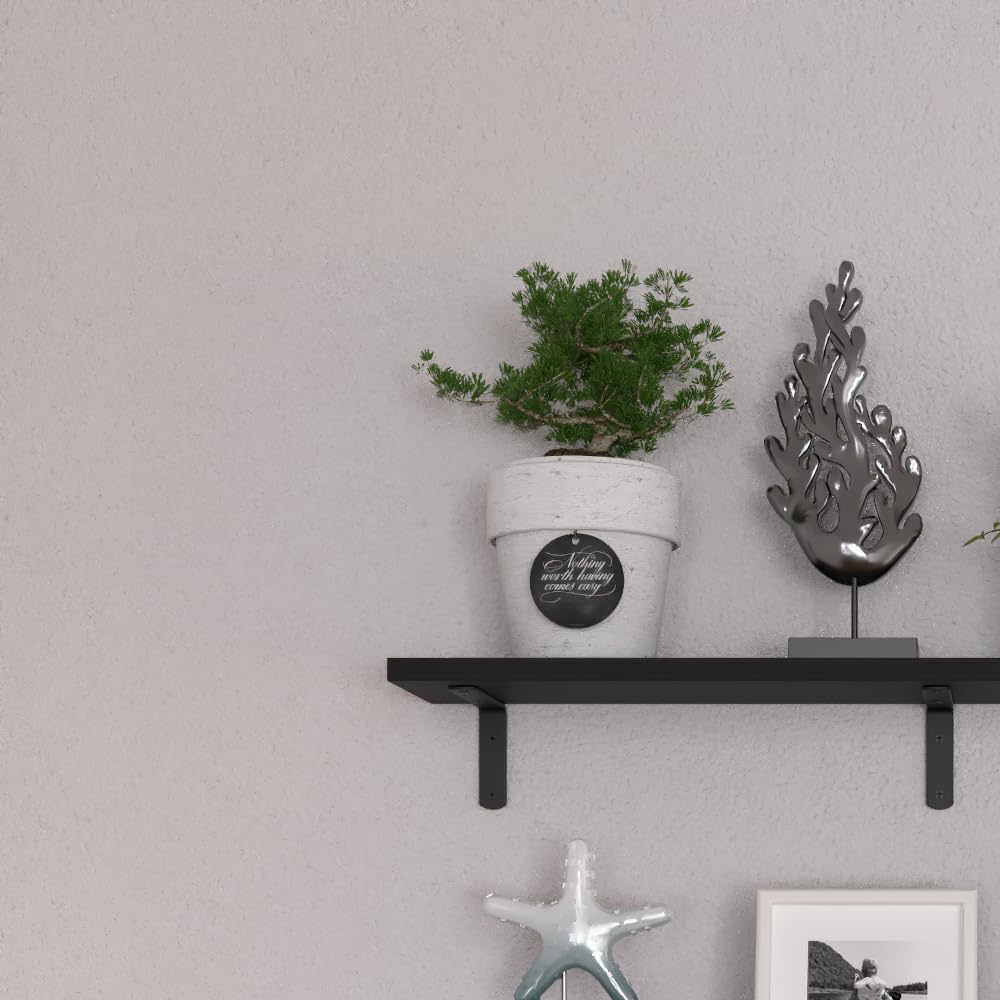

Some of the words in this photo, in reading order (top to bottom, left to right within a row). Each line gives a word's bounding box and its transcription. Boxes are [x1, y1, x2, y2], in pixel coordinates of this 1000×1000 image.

[540, 567, 574, 581] worth
[576, 568, 614, 587] having
[544, 583, 576, 591] comes
[577, 583, 602, 598] easy
